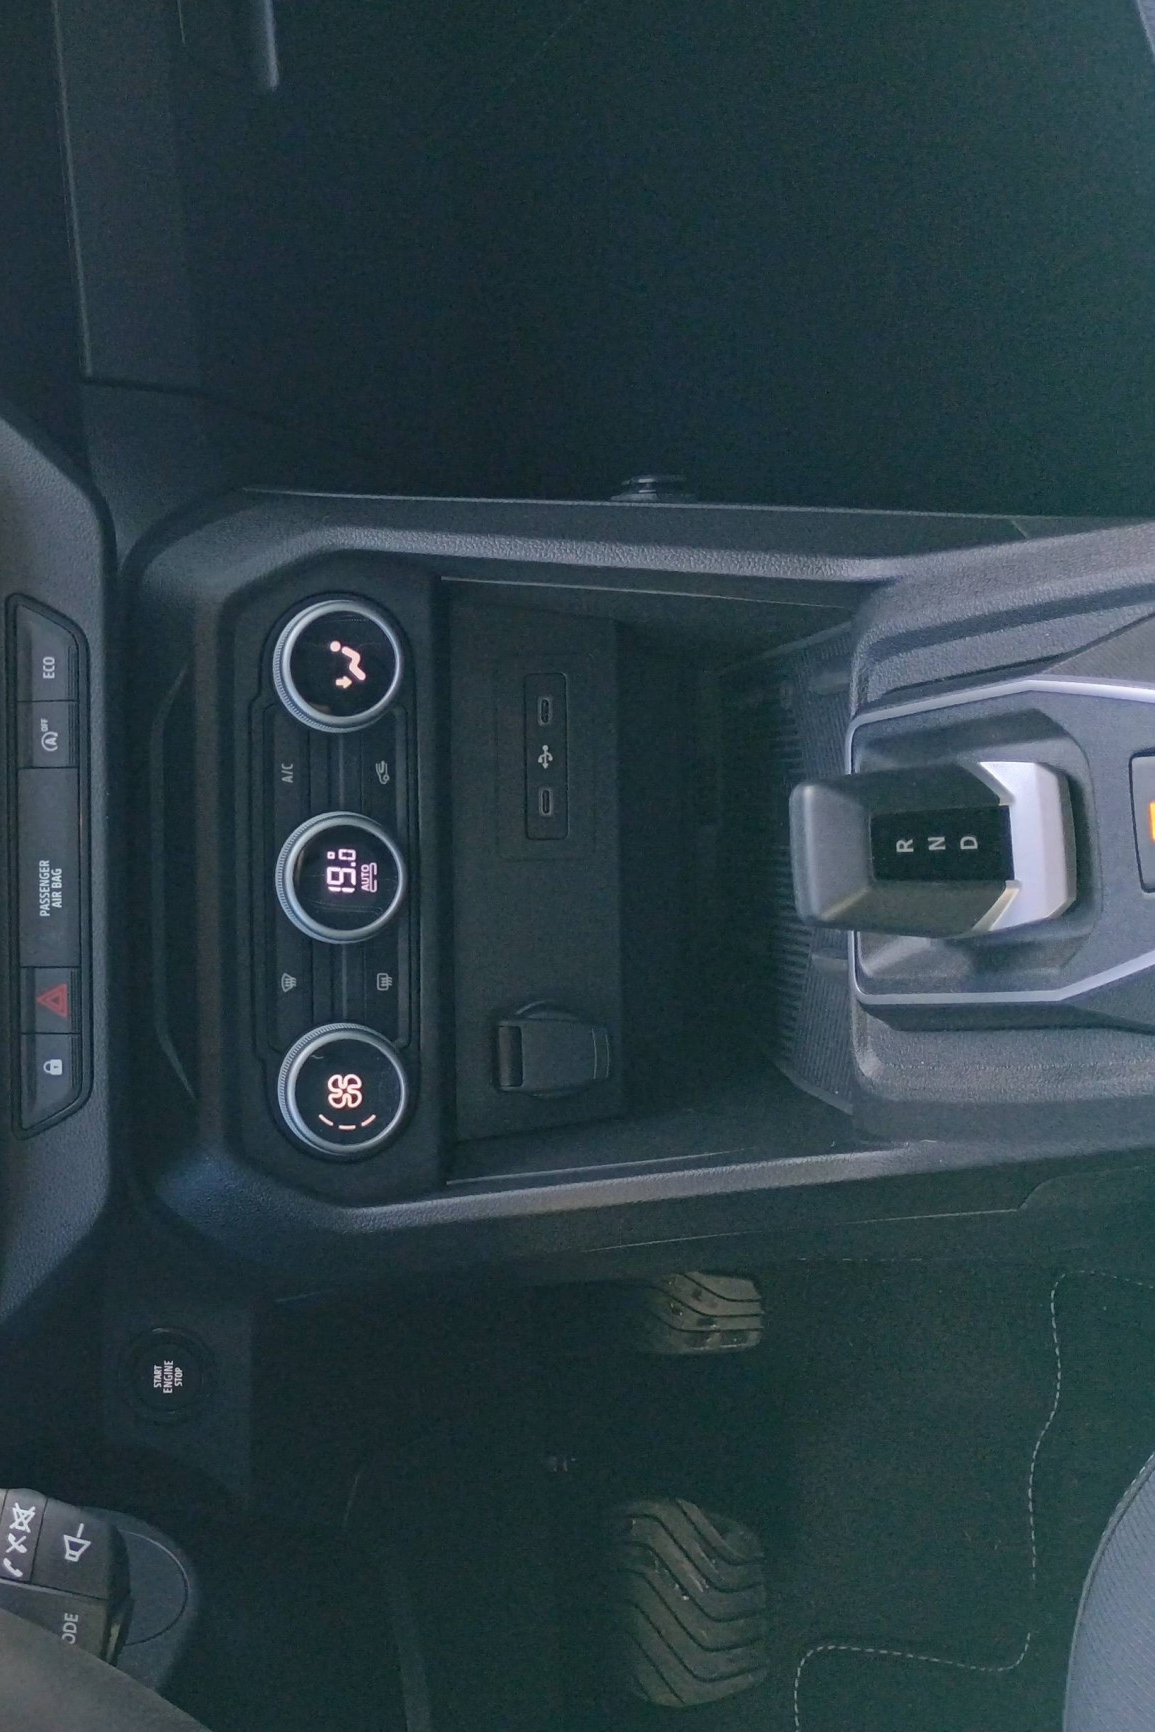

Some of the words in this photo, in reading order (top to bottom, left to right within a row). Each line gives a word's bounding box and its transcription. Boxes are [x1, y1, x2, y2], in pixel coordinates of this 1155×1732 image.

[42, 656, 55, 679] ECO
[40, 718, 49, 732] OFF
[281, 763, 294, 783] A/C
[896, 839, 914, 853] R
[928, 836, 946, 851] N
[960, 836, 978, 849] D
[50, 868, 62, 889] BAG
[361, 864, 370, 891] AUTO
[39, 860, 51, 917] PASSENGER
[50, 892, 62, 908] AIR
[154, 1364, 162, 1388] START
[163, 1360, 174, 1394] ENGINE
[174, 1367, 183, 1386] STOP
[62, 1613, 79, 1644] ODE
